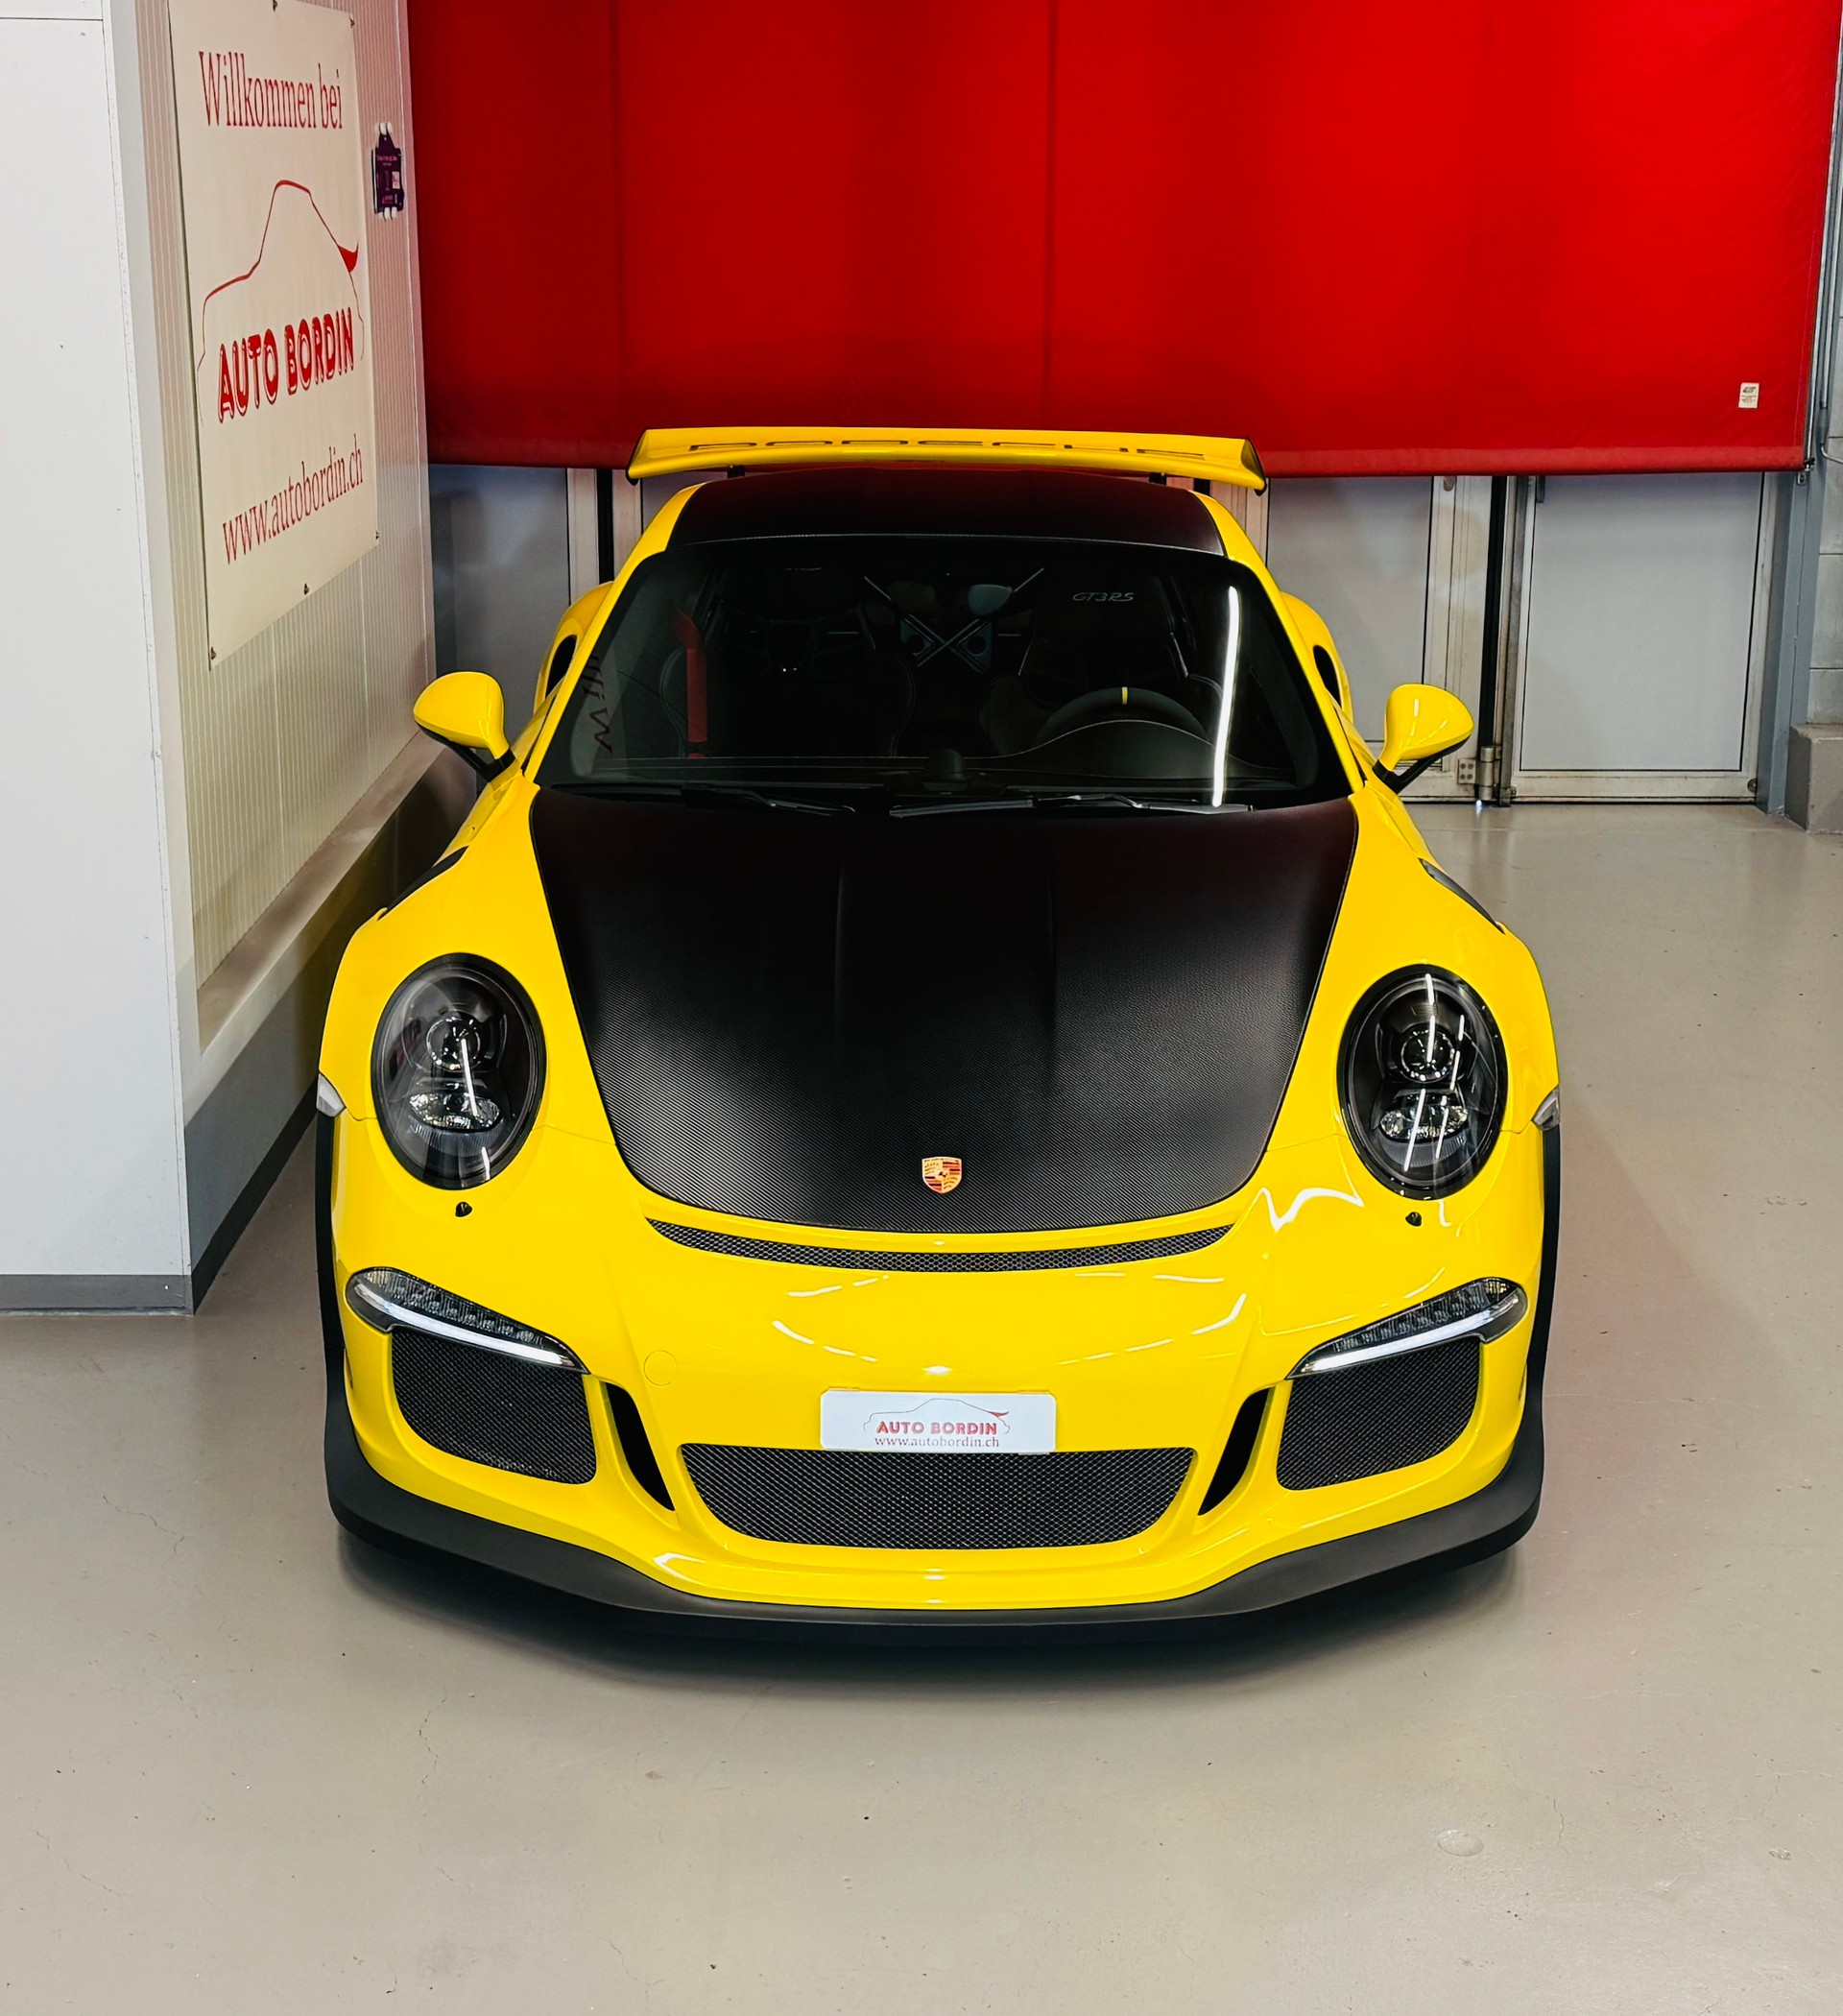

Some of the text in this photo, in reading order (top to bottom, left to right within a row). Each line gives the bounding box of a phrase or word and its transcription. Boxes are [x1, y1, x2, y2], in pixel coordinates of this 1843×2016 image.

[198, 51, 343, 130] Willkommen bei
[218, 306, 355, 423] AUTO BORDIN
[222, 433, 364, 564] www.autobordin.ch
[874, 1435, 999, 1448] www.autobordin.ch
[876, 1421, 997, 1435] AUTO BORDIN
